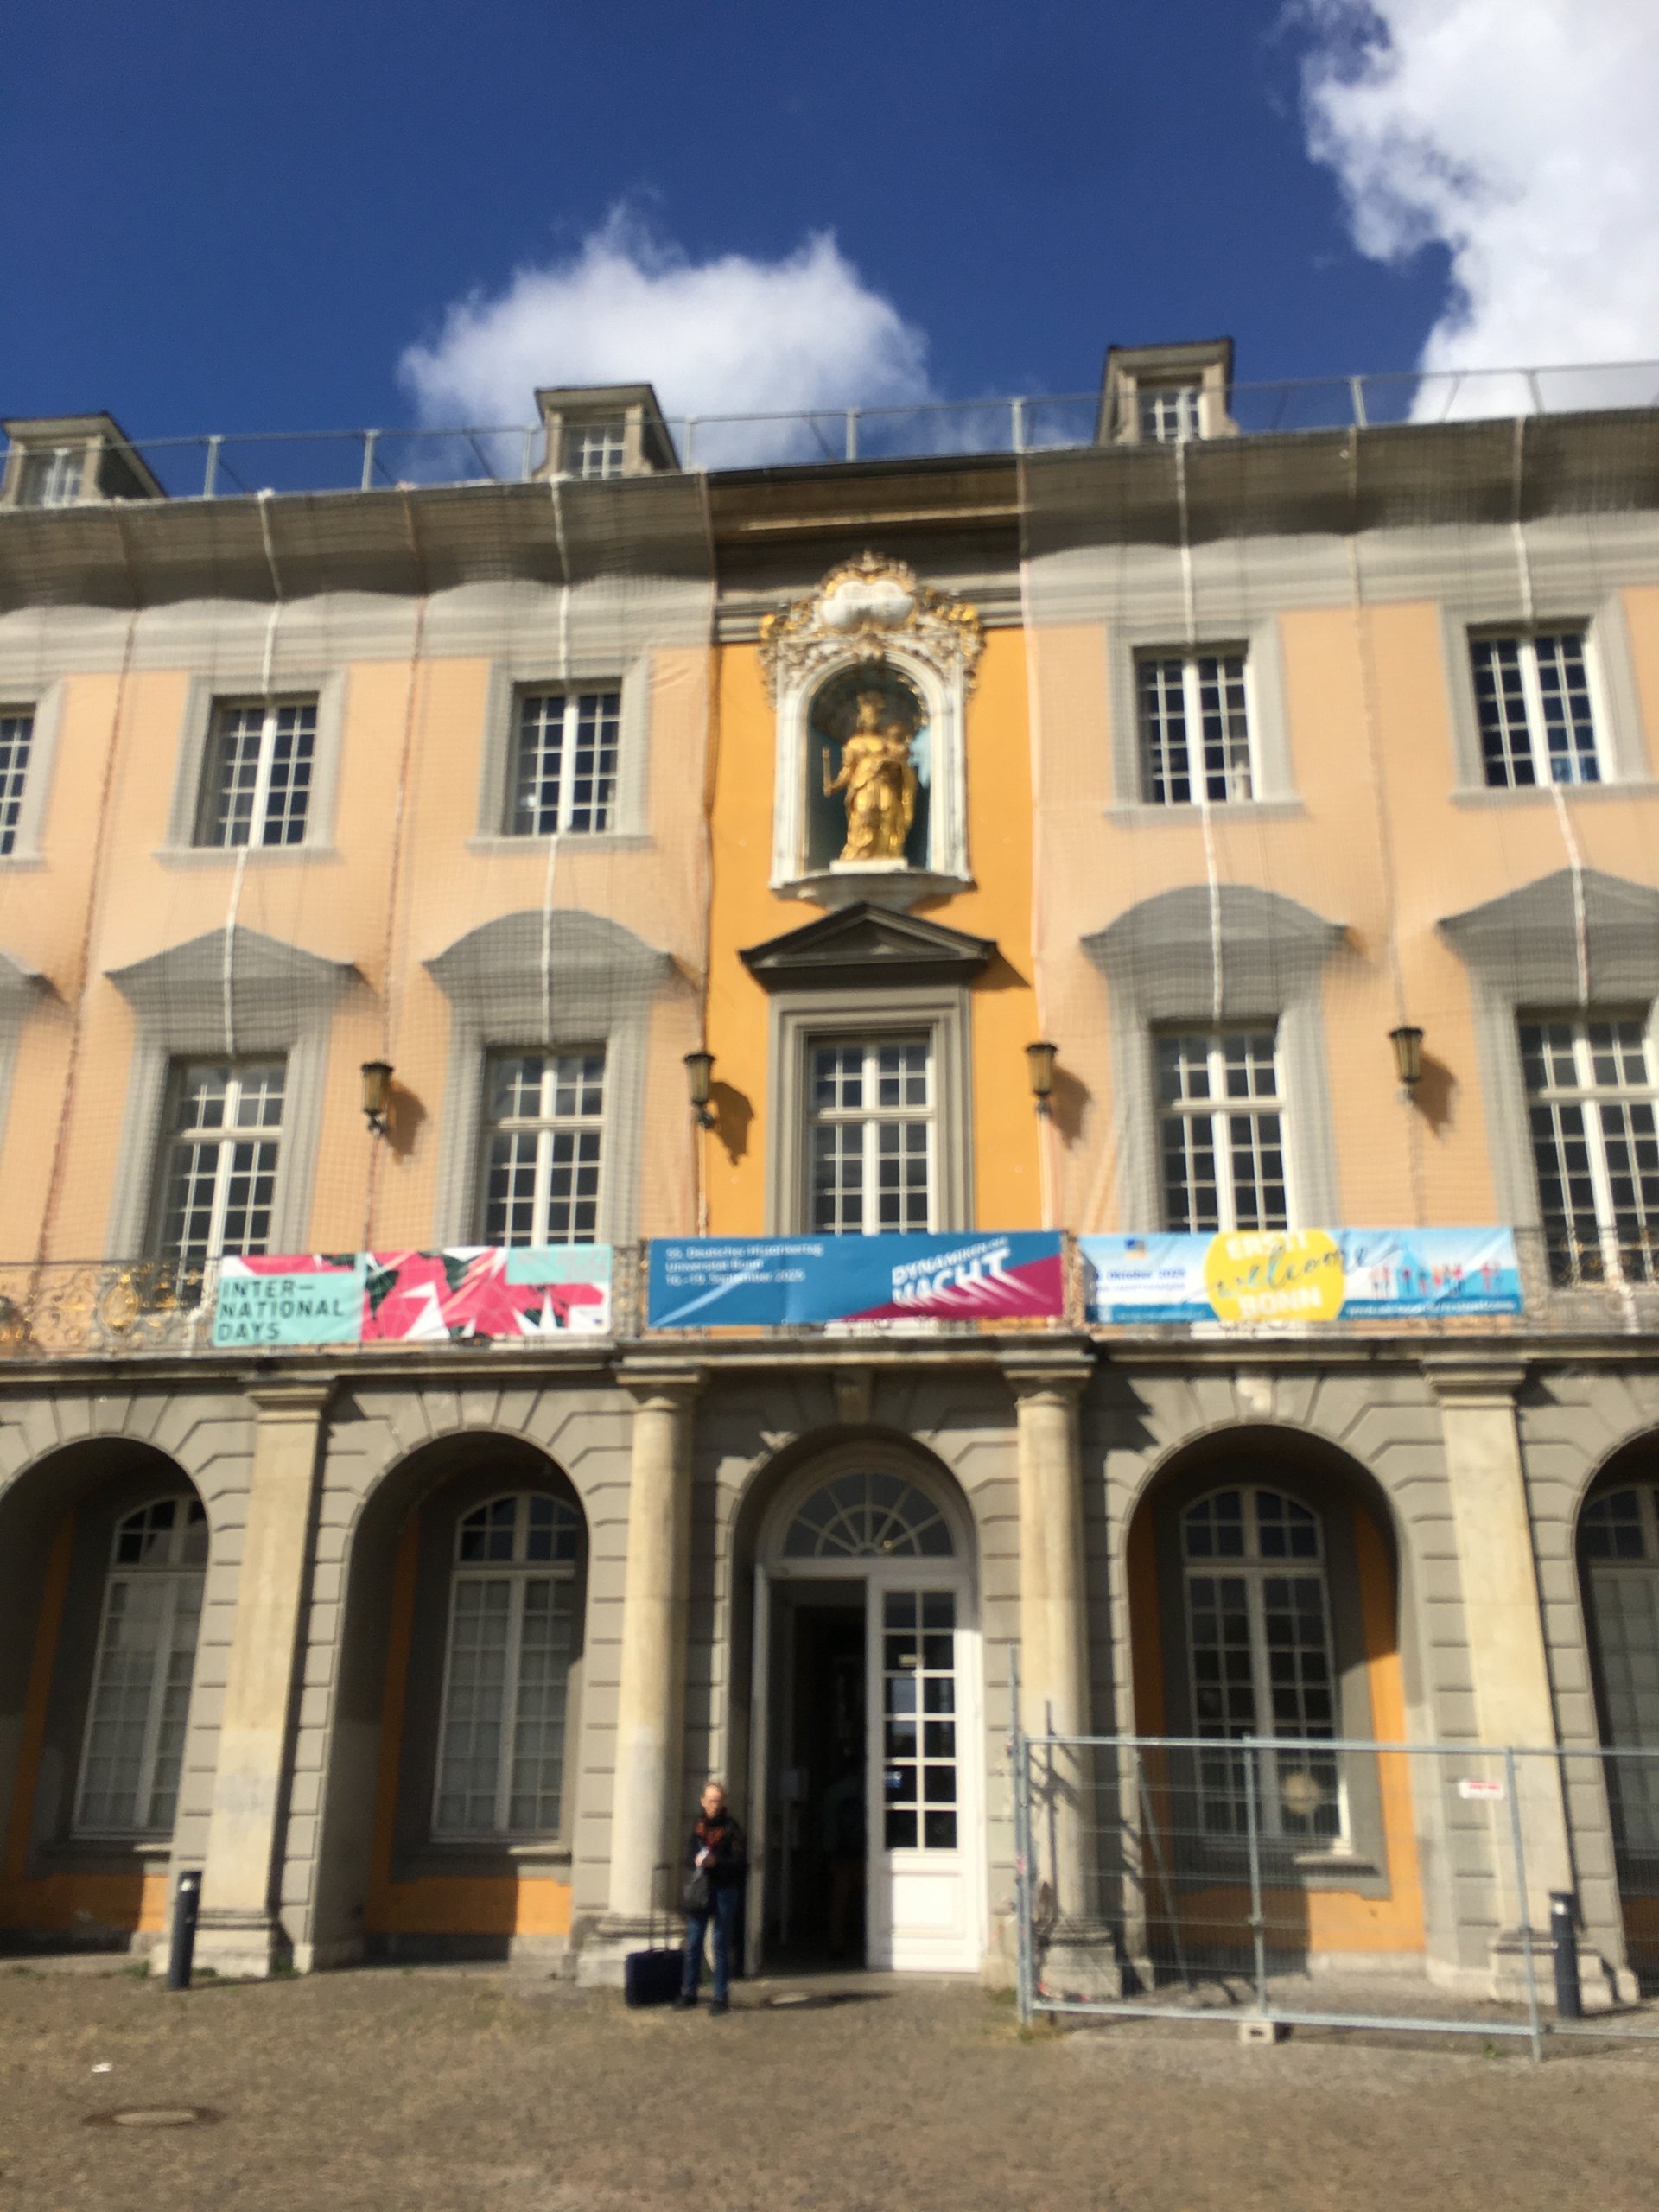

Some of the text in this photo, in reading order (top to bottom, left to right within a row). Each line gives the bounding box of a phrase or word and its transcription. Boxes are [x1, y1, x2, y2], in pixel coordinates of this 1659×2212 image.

[686, 1246, 746, 1259] Deutscher
[747, 1243, 824, 1257] Historikertag
[730, 1258, 764, 1271] Bonn
[892, 1243, 985, 1286] DYNAMIKEN
[709, 1270, 773, 1285] September
[892, 1247, 1011, 1303] MACHT
[219, 1299, 345, 1319] NATIONAL
[1238, 1285, 1323, 1319] BONN
[218, 1321, 282, 1341] DAYS
